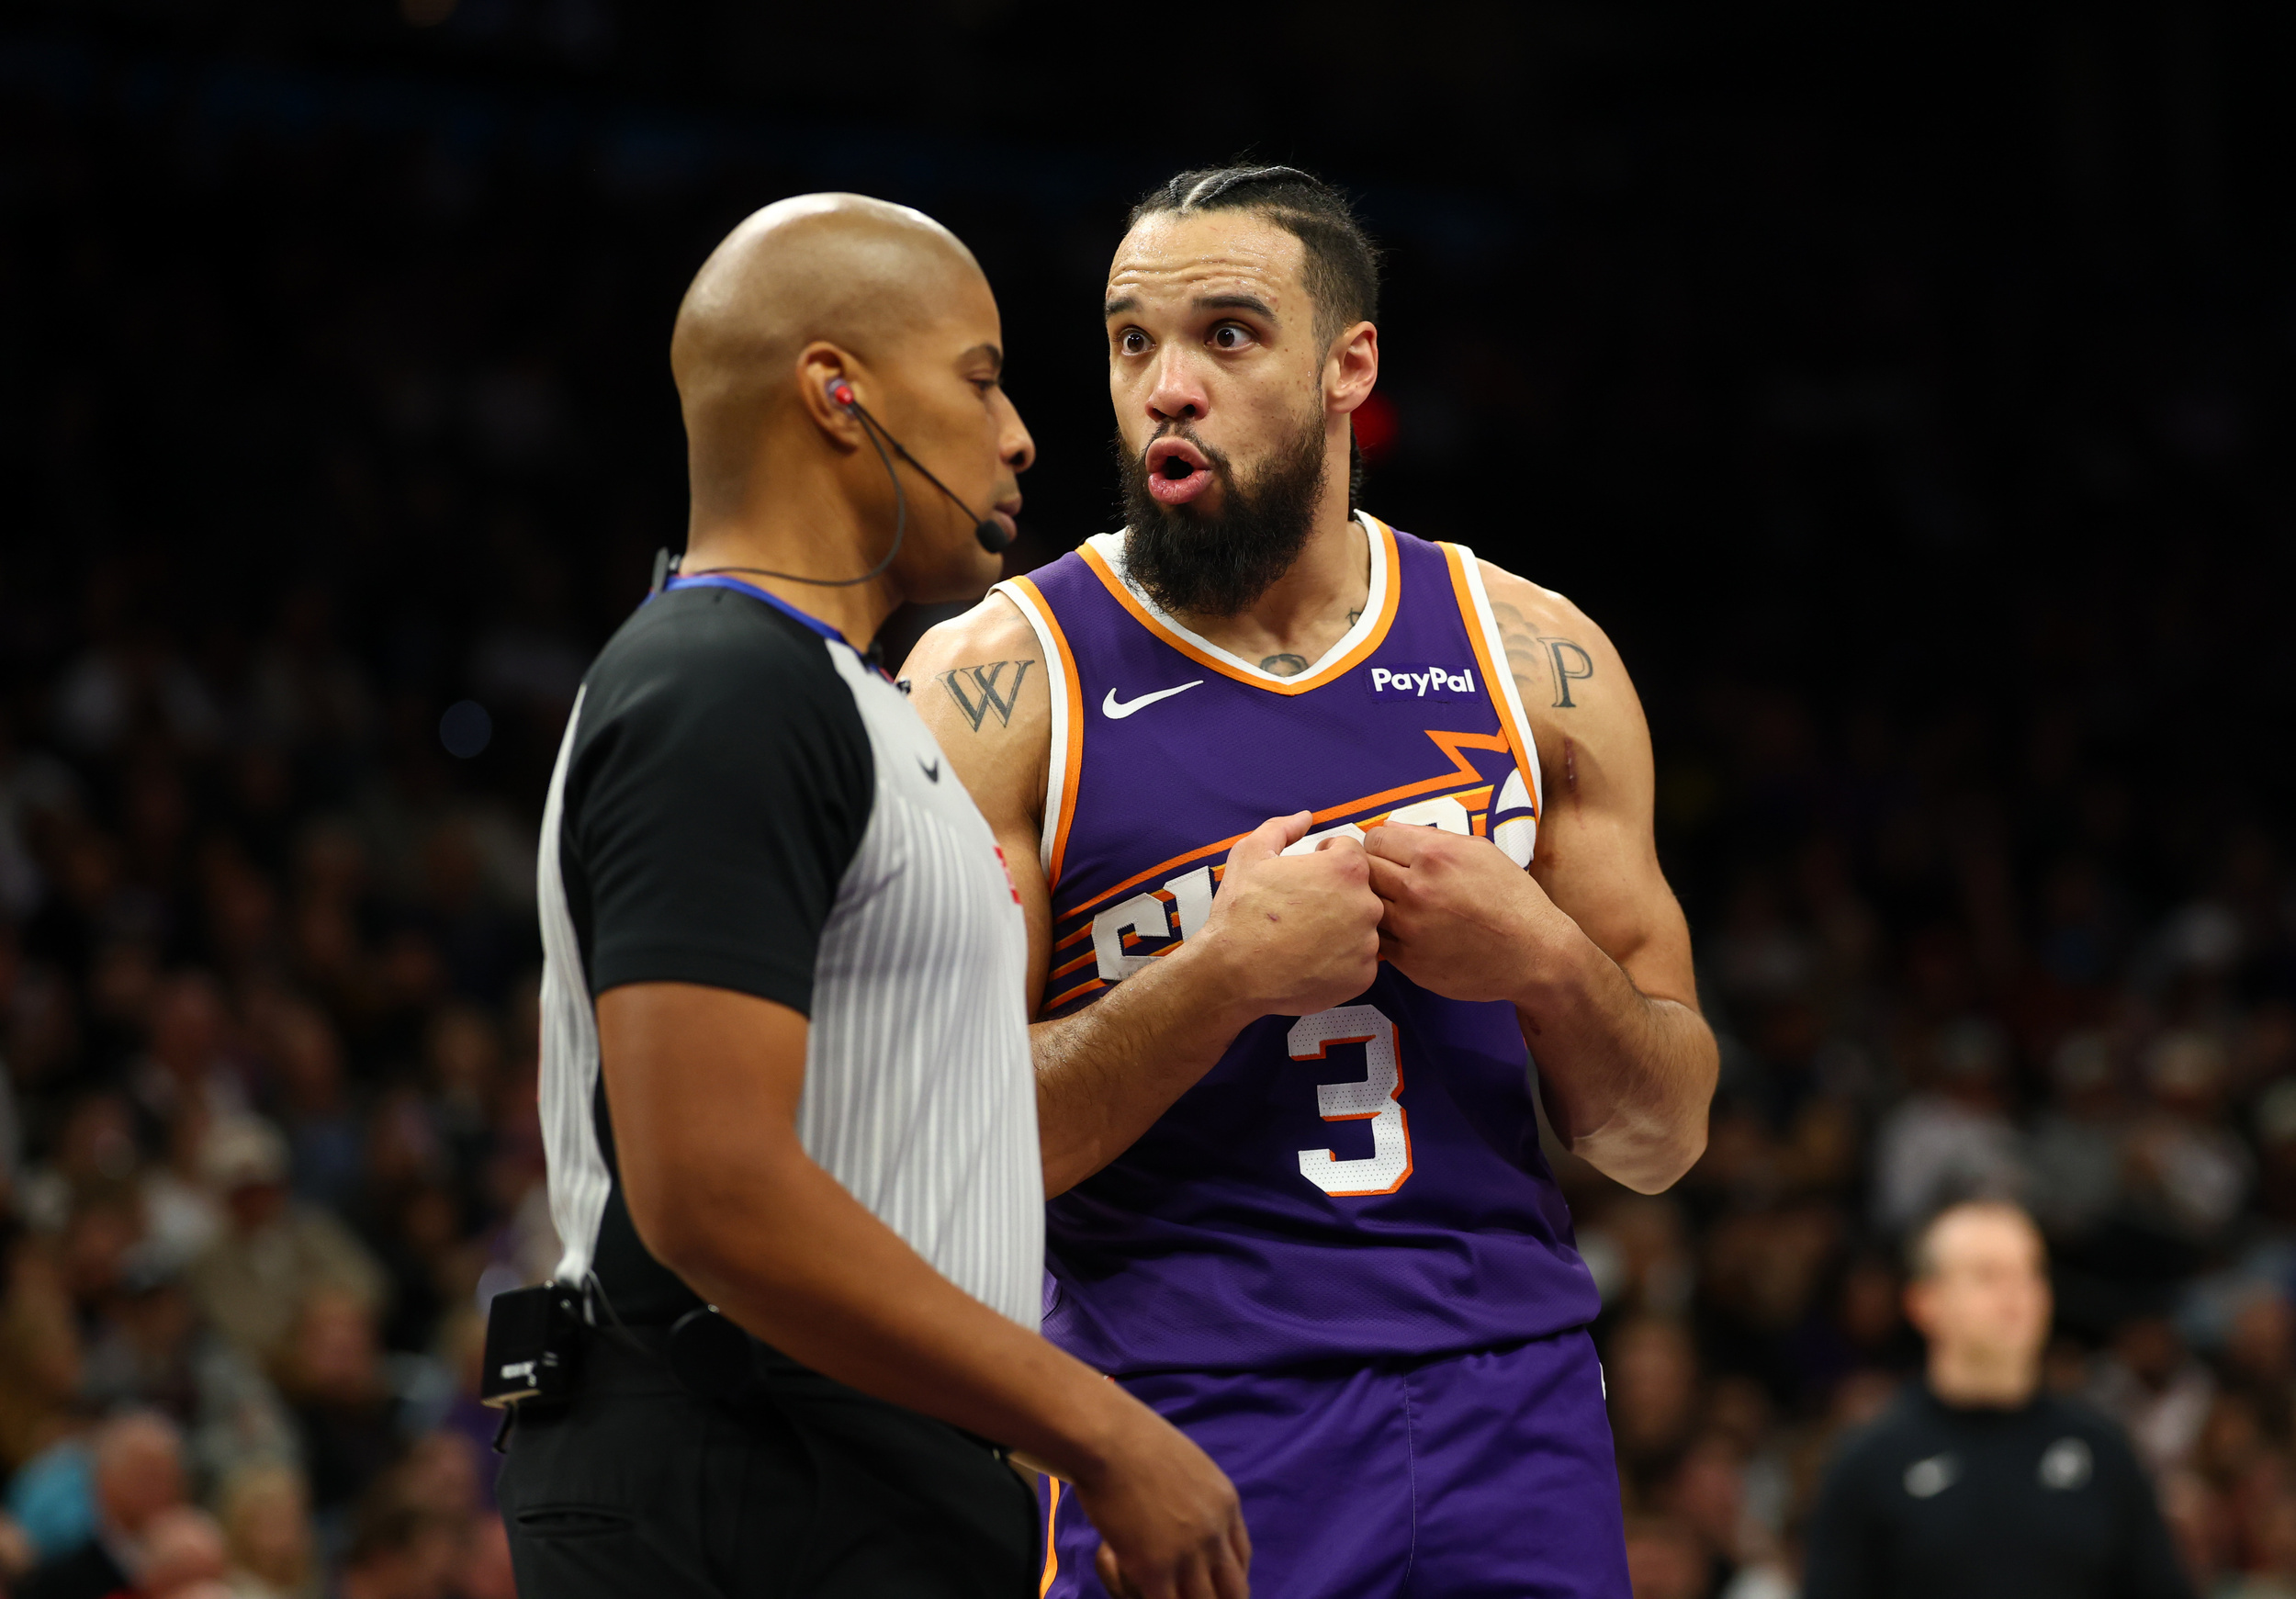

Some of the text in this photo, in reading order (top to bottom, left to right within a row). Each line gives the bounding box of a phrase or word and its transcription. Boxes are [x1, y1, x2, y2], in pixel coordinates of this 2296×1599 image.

[935, 659, 1036, 733] W
[1371, 666, 1476, 696] PayPal
[1536, 636, 1594, 708] P
[1287, 1004, 1413, 1197] 3
